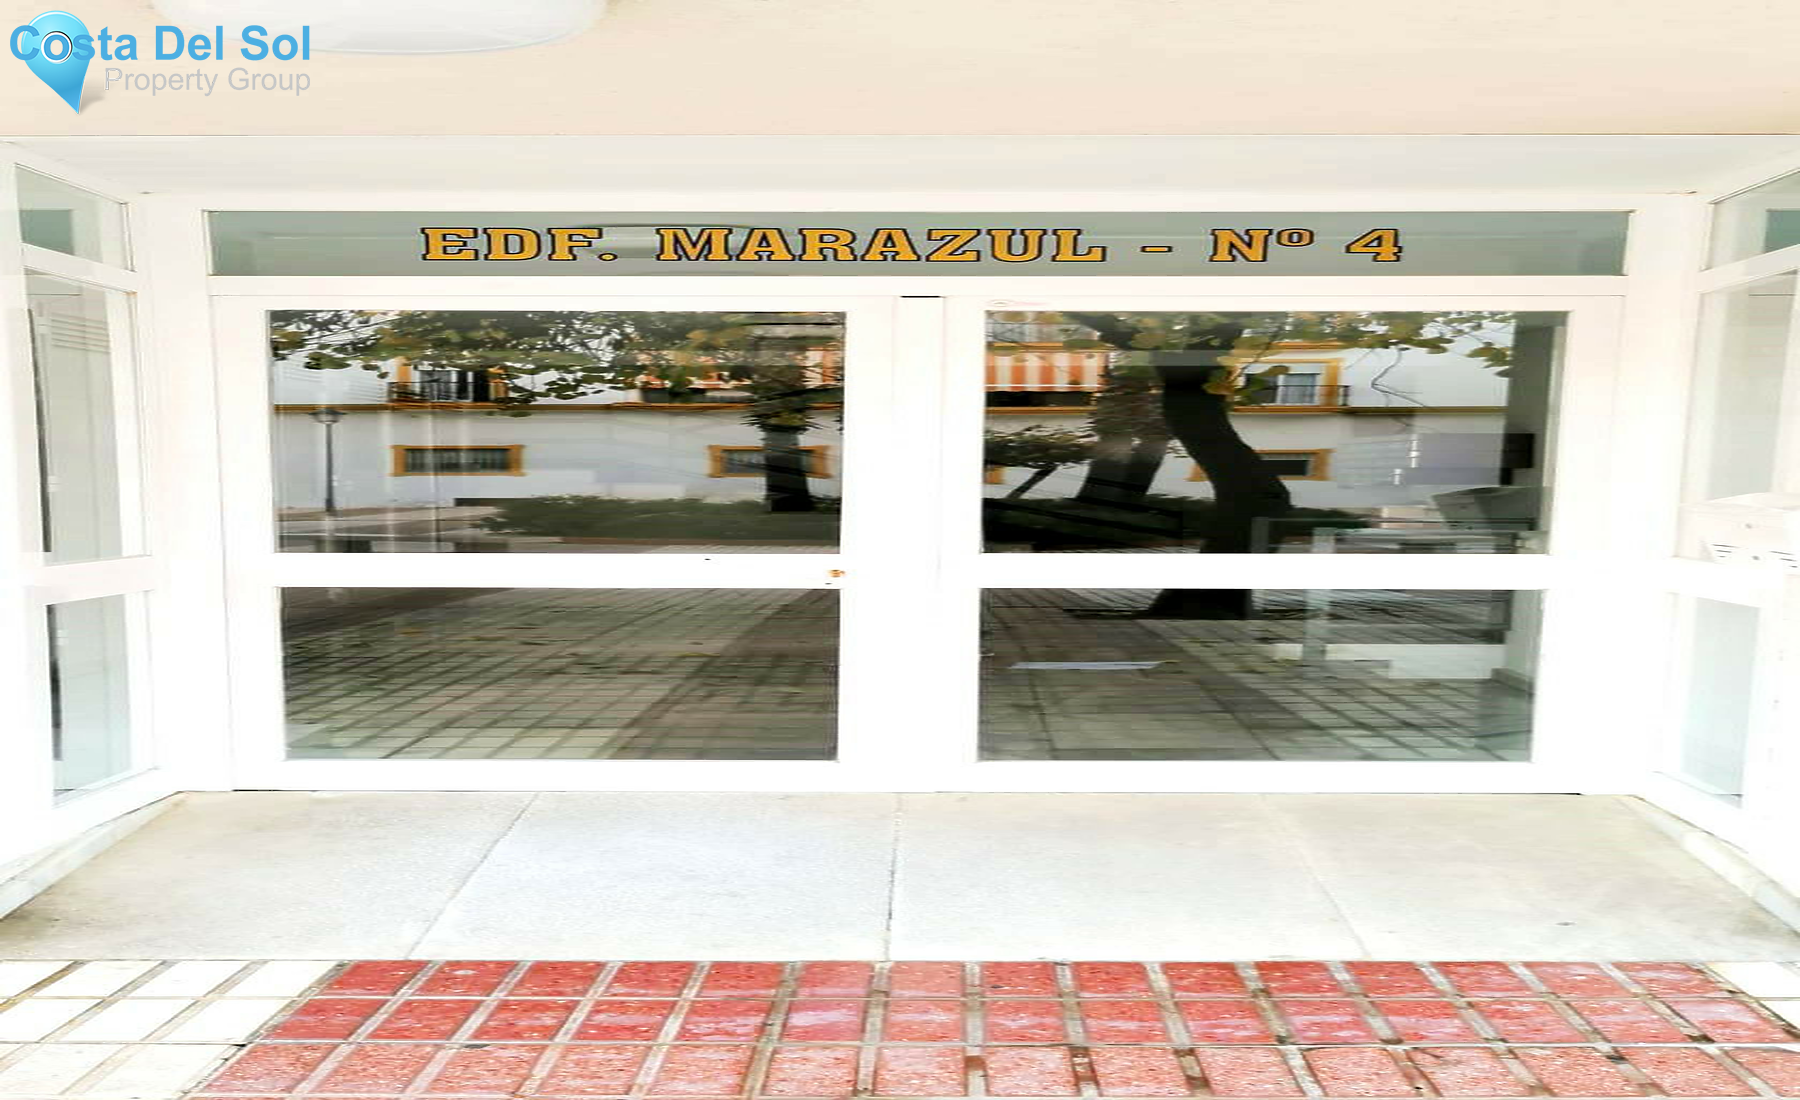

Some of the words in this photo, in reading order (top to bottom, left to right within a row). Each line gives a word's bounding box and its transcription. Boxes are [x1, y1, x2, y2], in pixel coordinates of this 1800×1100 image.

[420, 227, 618, 262] EDF.
[655, 227, 1107, 263] MARAZUL
[1209, 228, 1315, 263] Nº
[1345, 228, 1403, 263] 4
